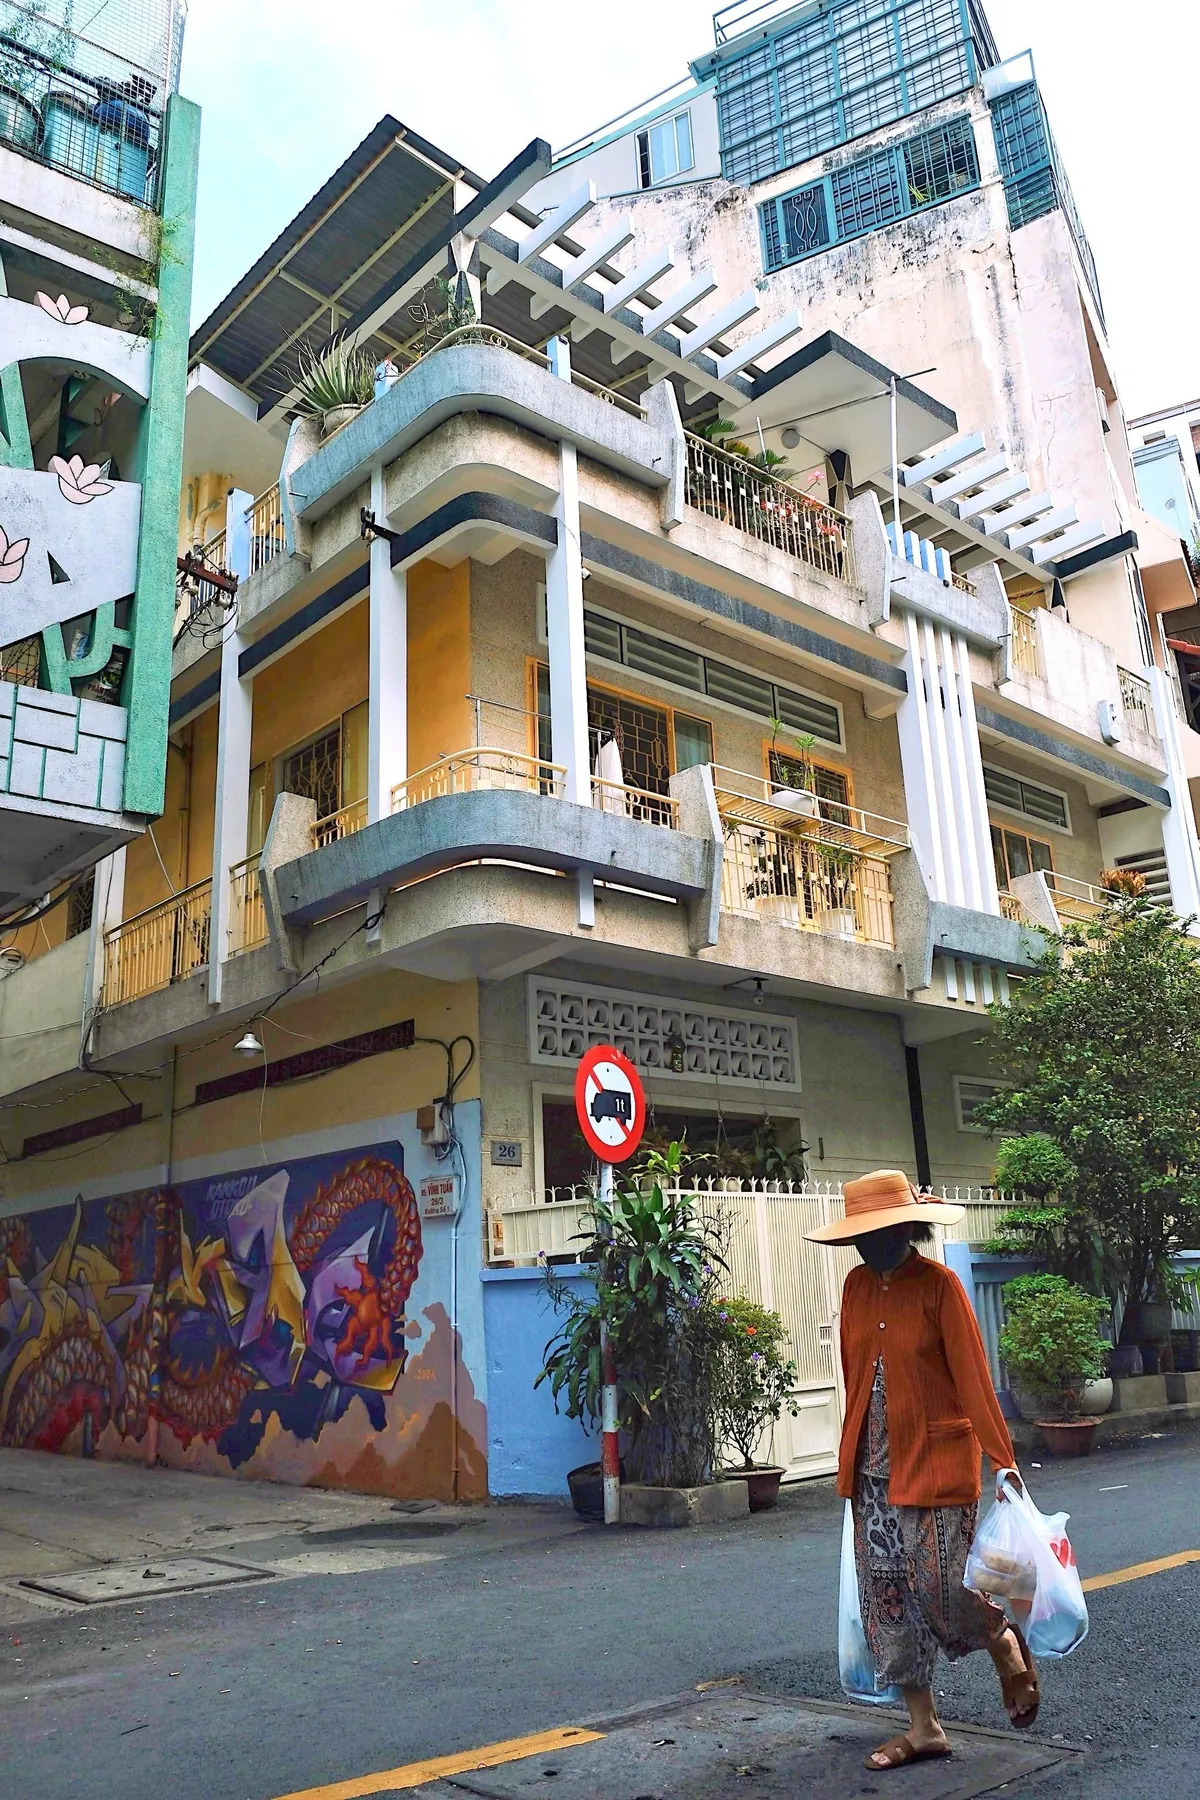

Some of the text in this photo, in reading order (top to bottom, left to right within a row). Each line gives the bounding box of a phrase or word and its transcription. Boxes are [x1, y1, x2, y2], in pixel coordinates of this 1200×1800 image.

[614, 1098, 625, 1113] 1t
[499, 1145, 516, 1159] 26
[428, 1183, 439, 1195] VĨNH
[431, 1197, 443, 1206] 26/3
